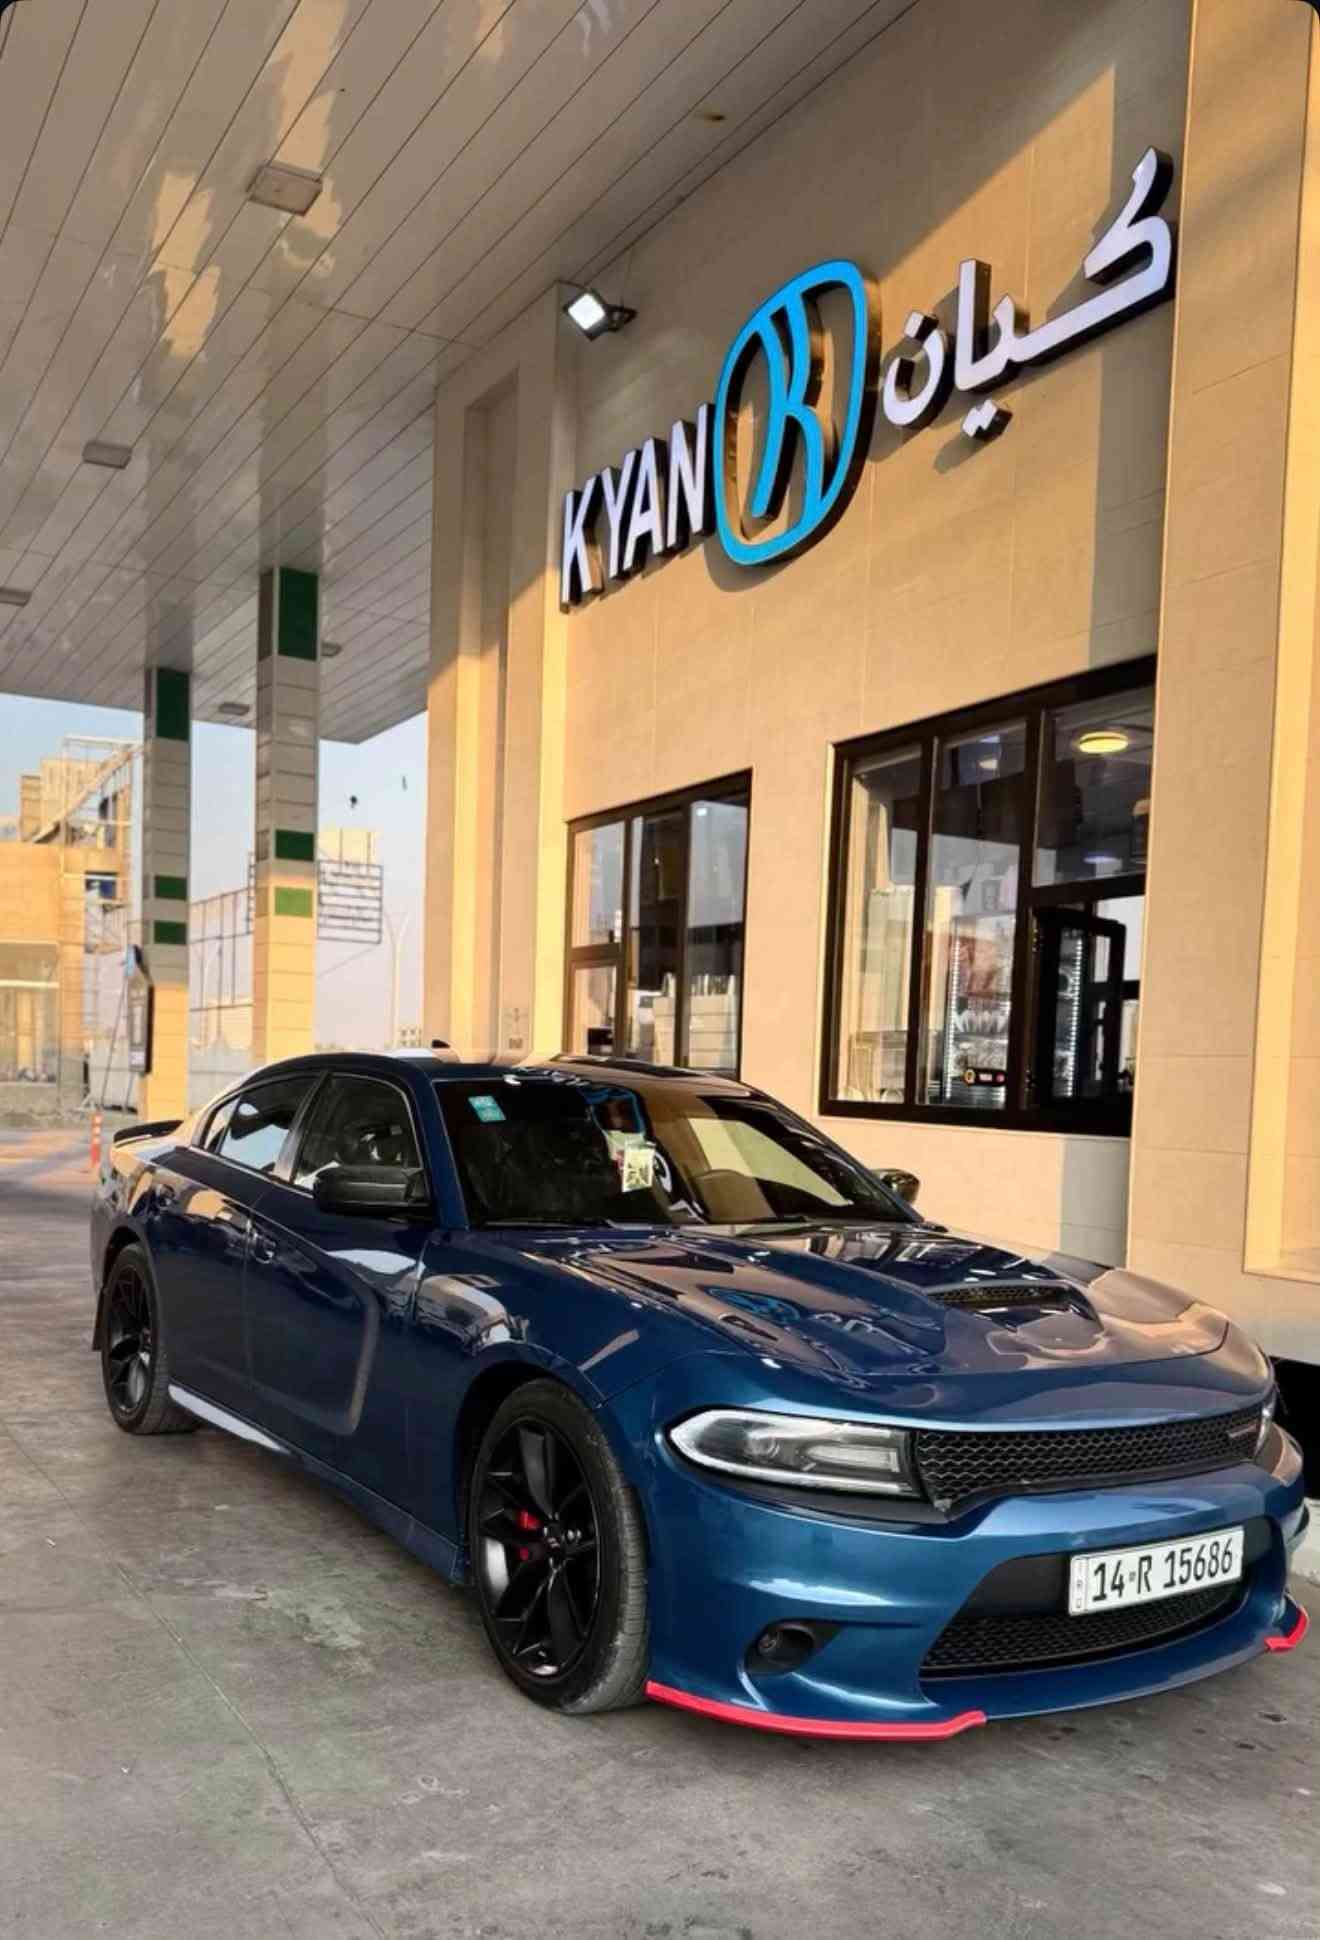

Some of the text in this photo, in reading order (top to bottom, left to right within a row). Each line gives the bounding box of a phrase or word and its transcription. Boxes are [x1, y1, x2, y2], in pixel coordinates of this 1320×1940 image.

[883, 146, 1173, 438] كيان
[561, 403, 713, 605] KYAN
[1163, 1538, 1233, 1588] 15686
